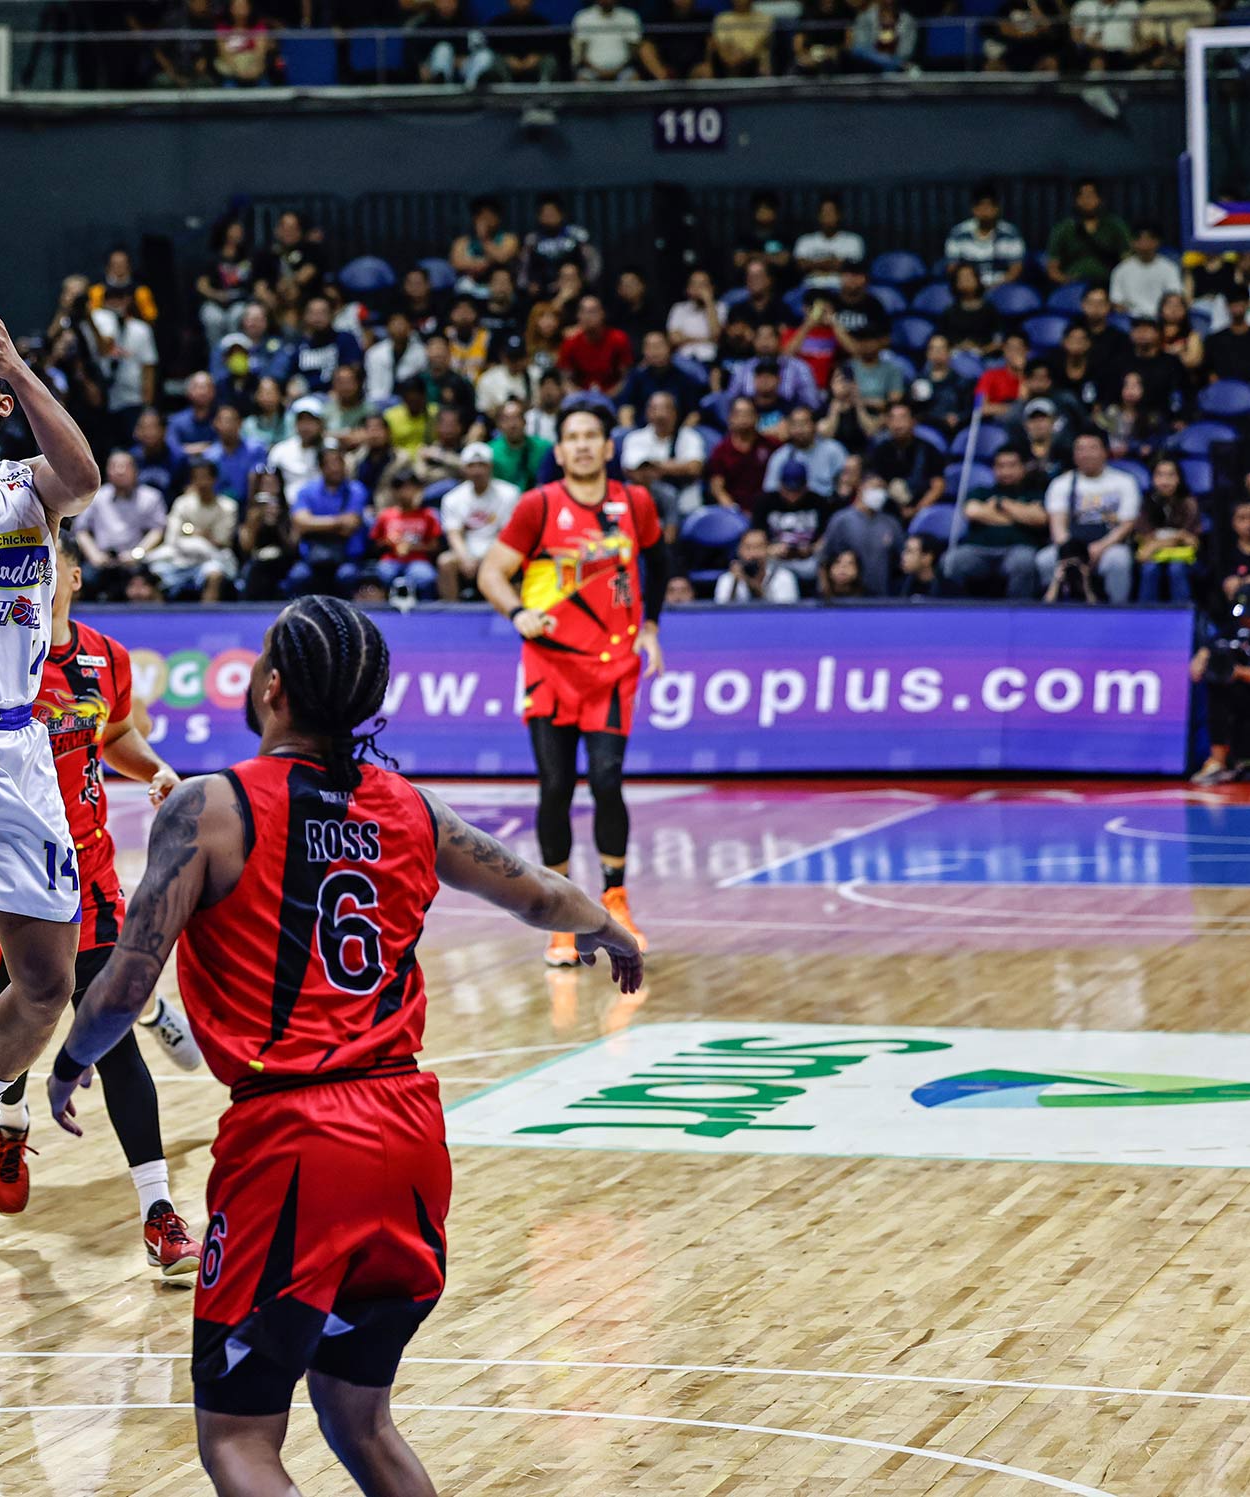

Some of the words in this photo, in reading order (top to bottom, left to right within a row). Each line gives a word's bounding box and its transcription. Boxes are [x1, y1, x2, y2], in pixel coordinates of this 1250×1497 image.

[658, 107, 722, 143] 110
[43, 840, 79, 892] 14
[305, 819, 381, 863] ROSS
[316, 869, 387, 996] 6
[200, 1210, 228, 1290] 6
